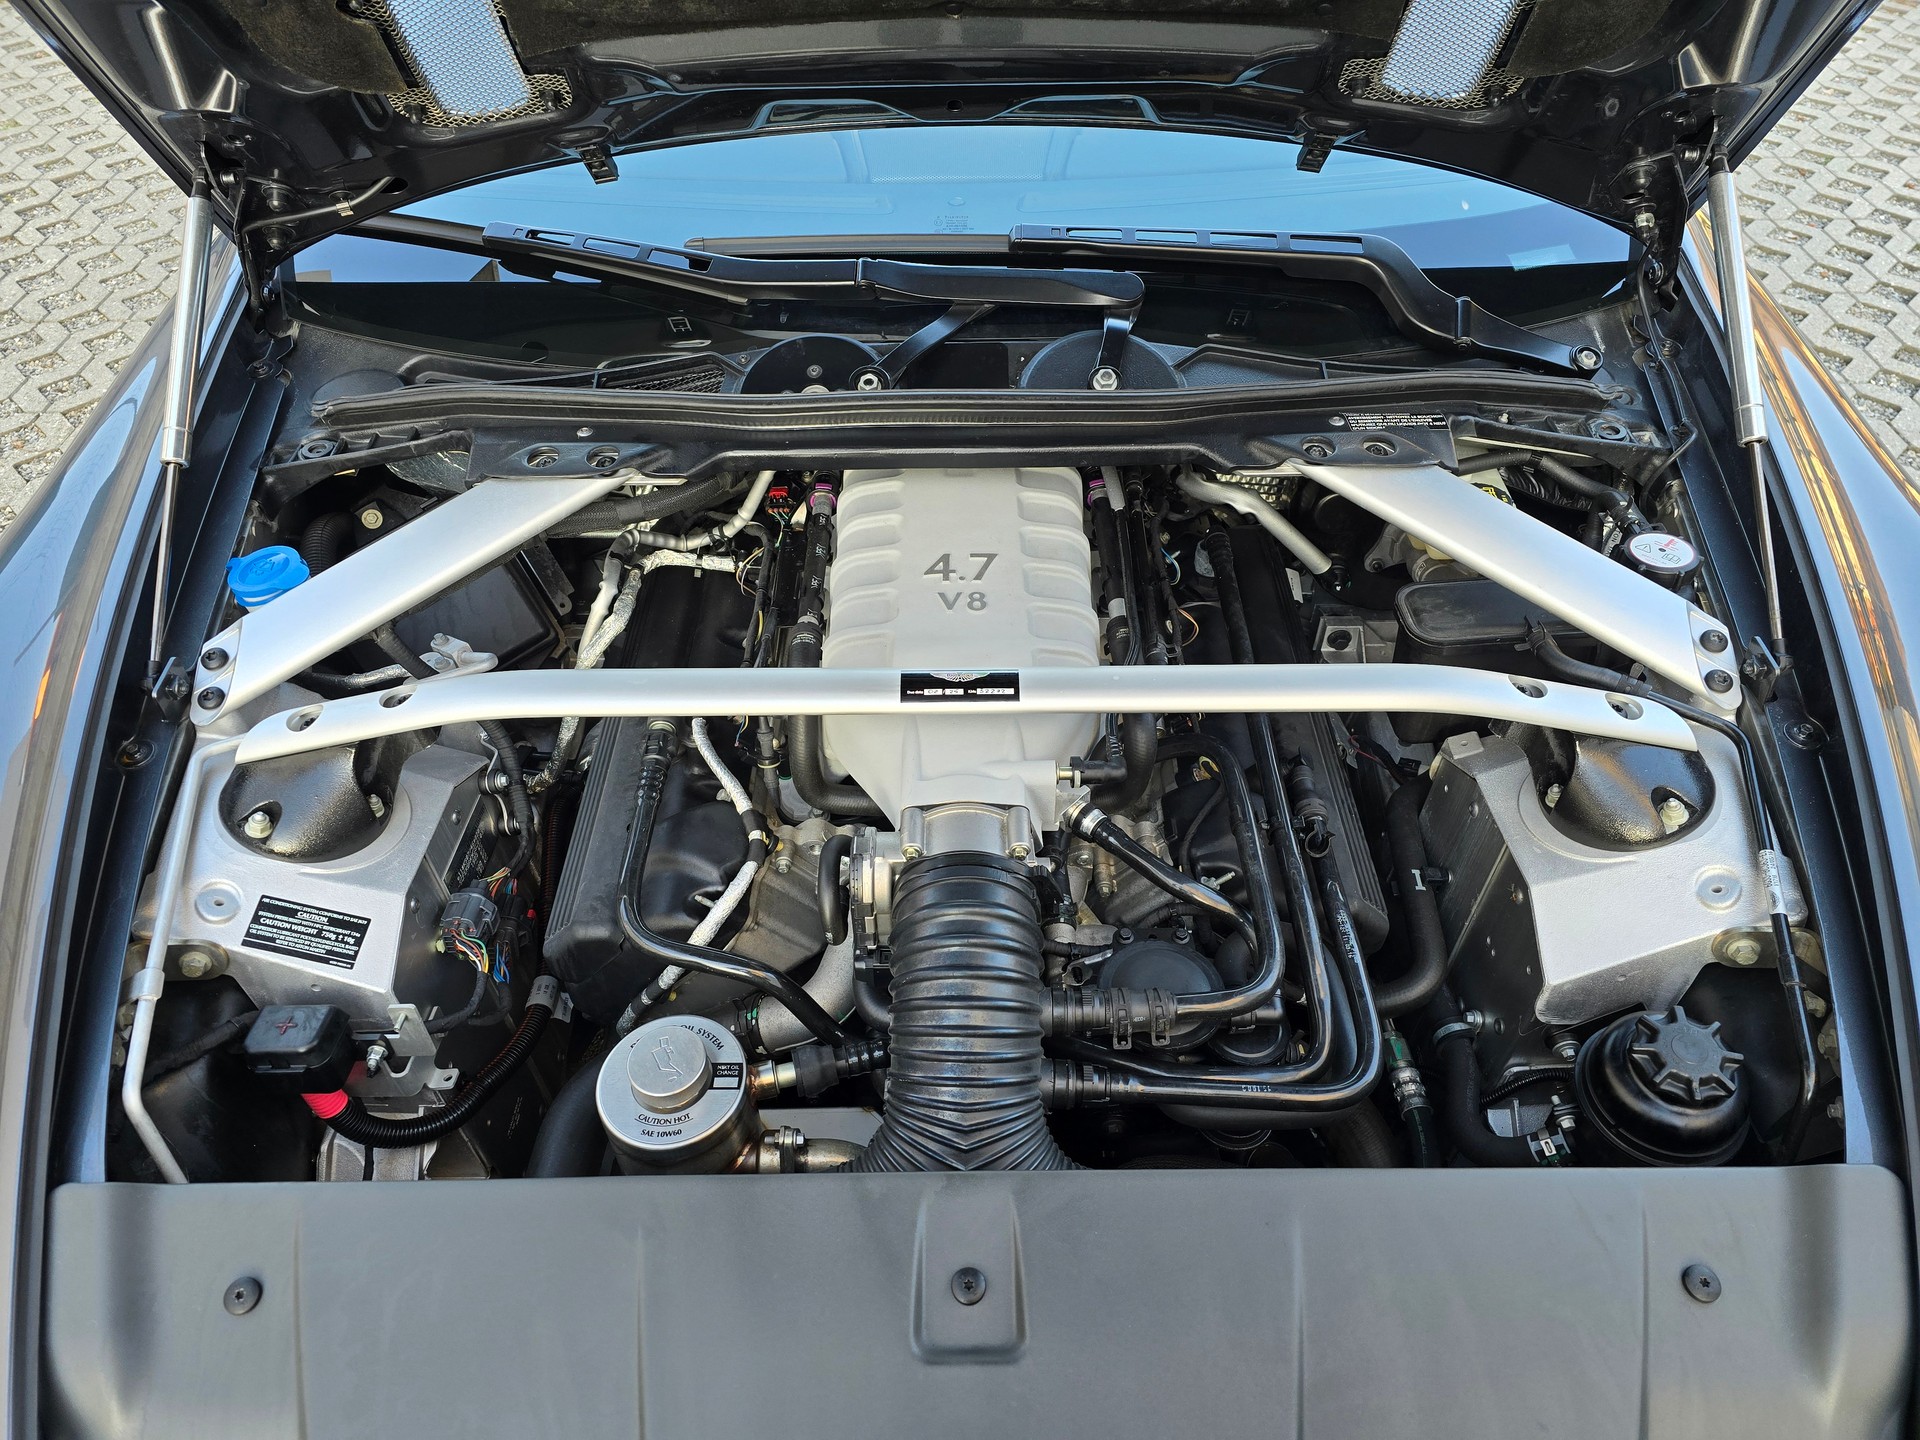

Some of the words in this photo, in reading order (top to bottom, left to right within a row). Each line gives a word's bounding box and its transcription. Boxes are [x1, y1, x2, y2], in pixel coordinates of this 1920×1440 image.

[923, 553, 998, 581] 4.7
[937, 592, 987, 611] V8
[297, 911, 328, 922] CAUTION
[260, 918, 291, 928] CAUTION
[291, 924, 318, 934] WEIGHT
[320, 931, 337, 939] 750g
[696, 1028, 724, 1050] SYSTEM
[638, 1113, 672, 1124] CAUTION
[674, 1113, 690, 1123] HOT
[641, 1128, 654, 1137] SAE
[657, 1129, 682, 1138] 10W60
